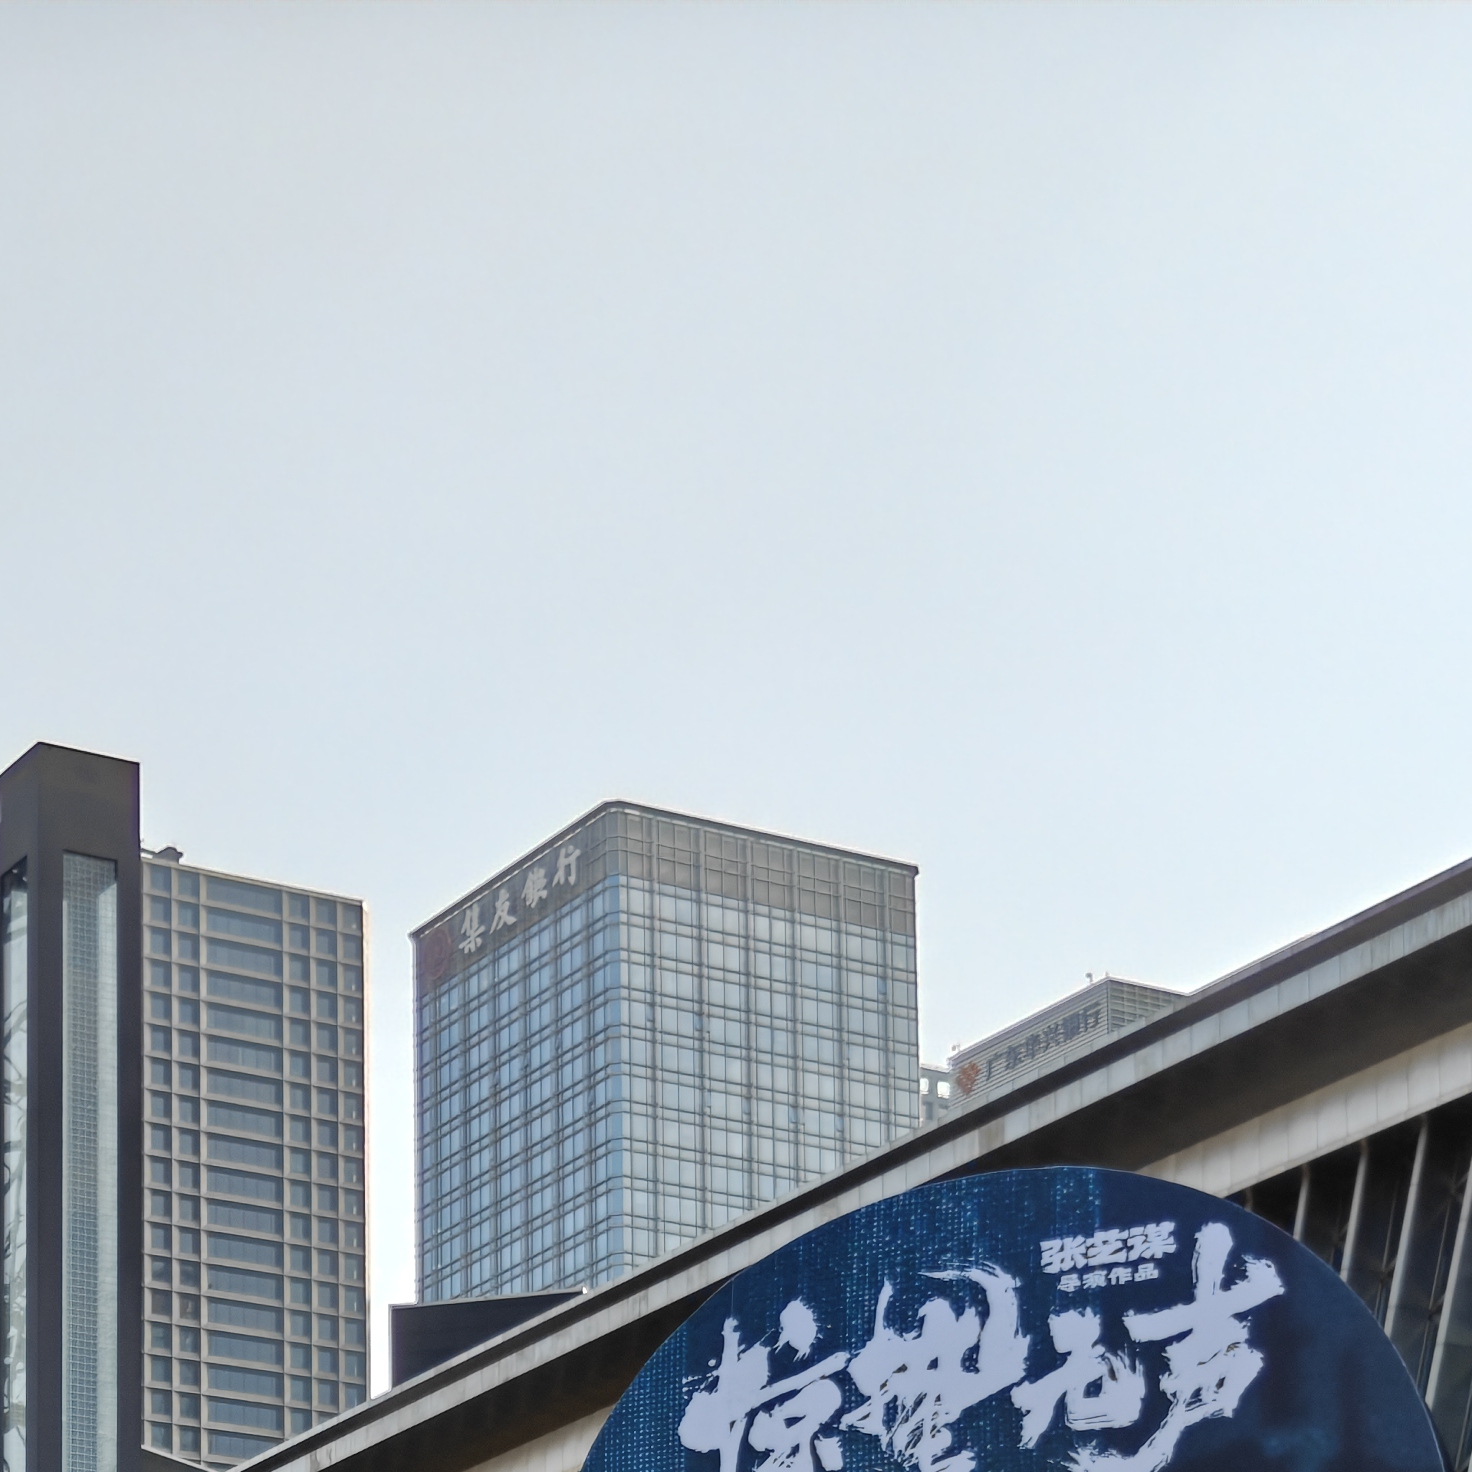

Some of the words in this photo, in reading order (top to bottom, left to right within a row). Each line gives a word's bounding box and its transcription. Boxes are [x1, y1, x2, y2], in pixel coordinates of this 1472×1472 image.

[458, 845, 581, 953] 集友银行
[1040, 1221, 1176, 1274] 张艺谋
[1058, 1263, 1158, 1293] 导演作品
